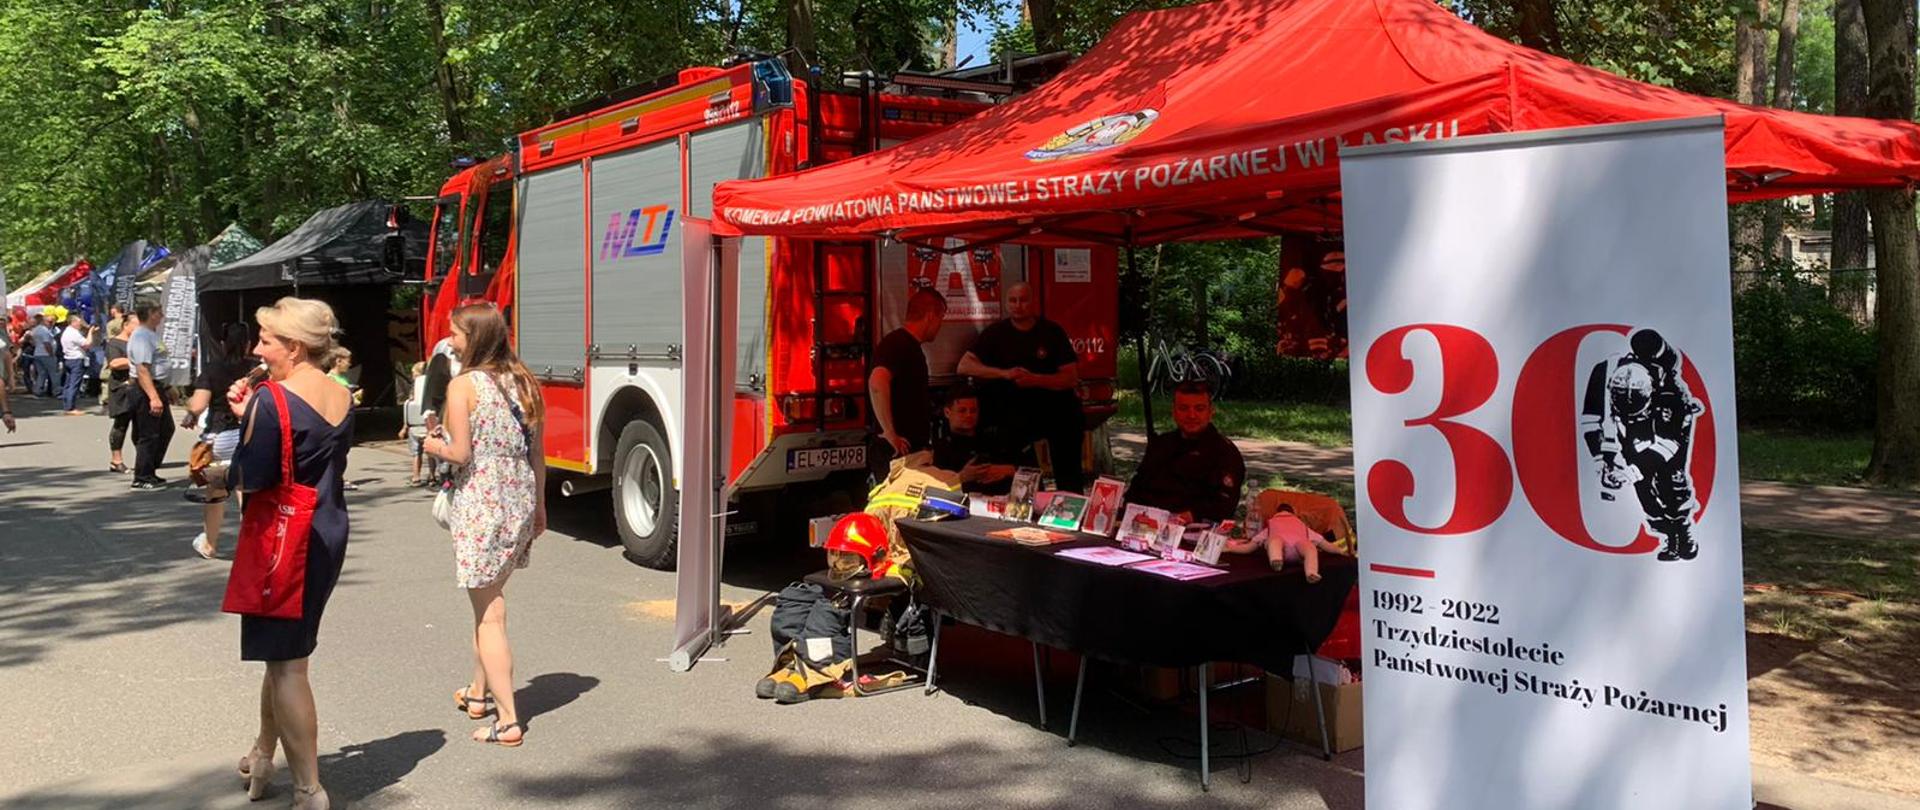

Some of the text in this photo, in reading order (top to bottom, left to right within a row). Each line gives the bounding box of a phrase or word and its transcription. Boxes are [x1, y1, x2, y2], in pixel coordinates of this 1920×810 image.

[723, 206, 790, 226] KOMENDA
[792, 195, 895, 225] POWIATOWA
[1134, 145, 1287, 191] POŻARNEJ
[1299, 138, 1326, 169] W
[166, 275, 187, 318] BRYGADA
[798, 447, 863, 468] EL 9EM98
[1365, 323, 1717, 555] 30
[1373, 589, 1423, 614] 1992
[1441, 598, 1500, 625] 2022
[1373, 618, 1565, 667] Trzydziestolecie
[1373, 648, 1729, 733] Państwowej Straży Pożarnej
